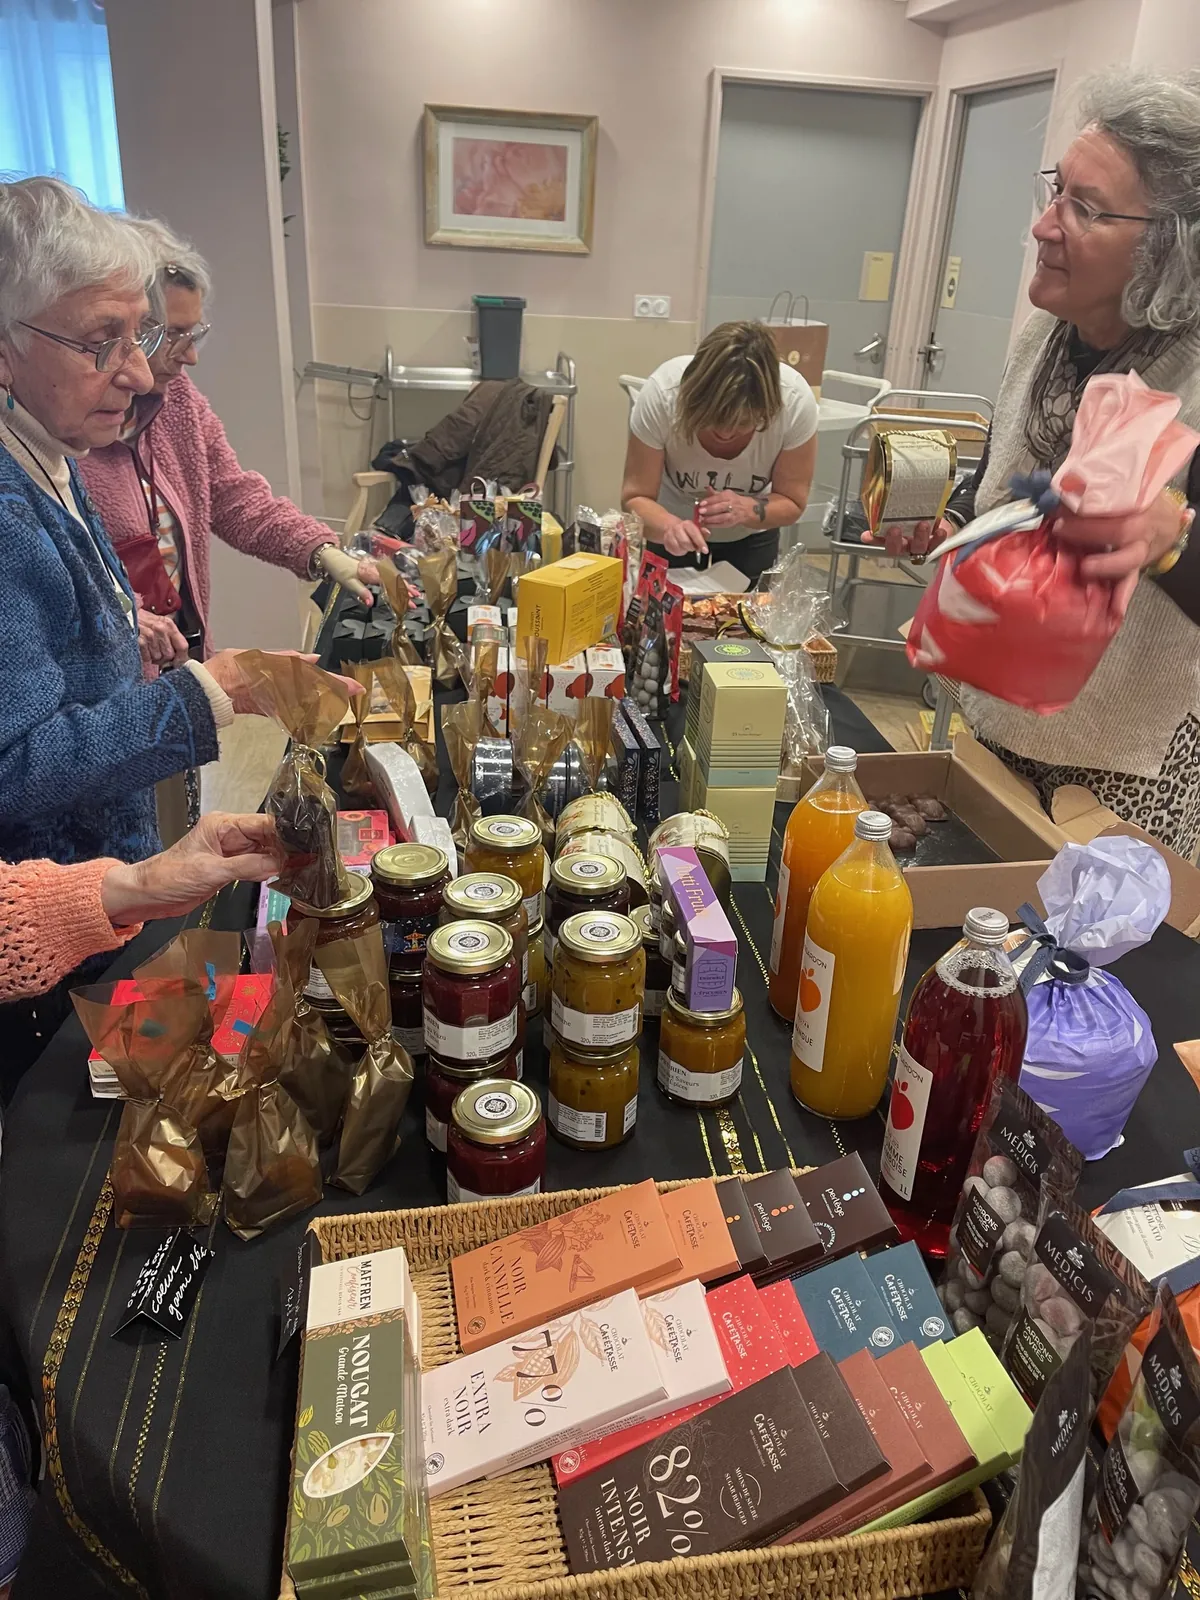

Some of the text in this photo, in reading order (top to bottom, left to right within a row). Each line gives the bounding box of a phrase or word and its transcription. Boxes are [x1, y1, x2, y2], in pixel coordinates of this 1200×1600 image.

[1000, 1126, 1040, 1175] MÉDICIS
[360, 1260, 372, 1310] MAFFREN
[490, 1245, 515, 1325] CANNELLE
[510, 1256, 527, 1296] NOIR
[896, 1278, 914, 1310] CHOCOLAT
[1044, 1240, 1094, 1302] MÉDICIS
[842, 1290, 862, 1322] CHOCOLAT
[337, 1346, 350, 1382] Grande
[350, 1333, 372, 1428] NOUGAT
[511, 1328, 568, 1427] 77%
[452, 1385, 472, 1436] NOIR
[470, 1370, 493, 1436] EXTRA
[968, 1376, 994, 1412] CHOCOLAT
[1148, 1354, 1183, 1426] MÉDICIS
[443, 1397, 456, 1437] extra dark
[766, 1417, 788, 1458] CHOCOLAT
[808, 1401, 830, 1440] CHOCOLAT
[624, 1484, 651, 1545] NOIR
[648, 1444, 710, 1554] 82%
[724, 1472, 748, 1526] SUGAR REDUCED
[594, 1506, 616, 1563] intense dark
